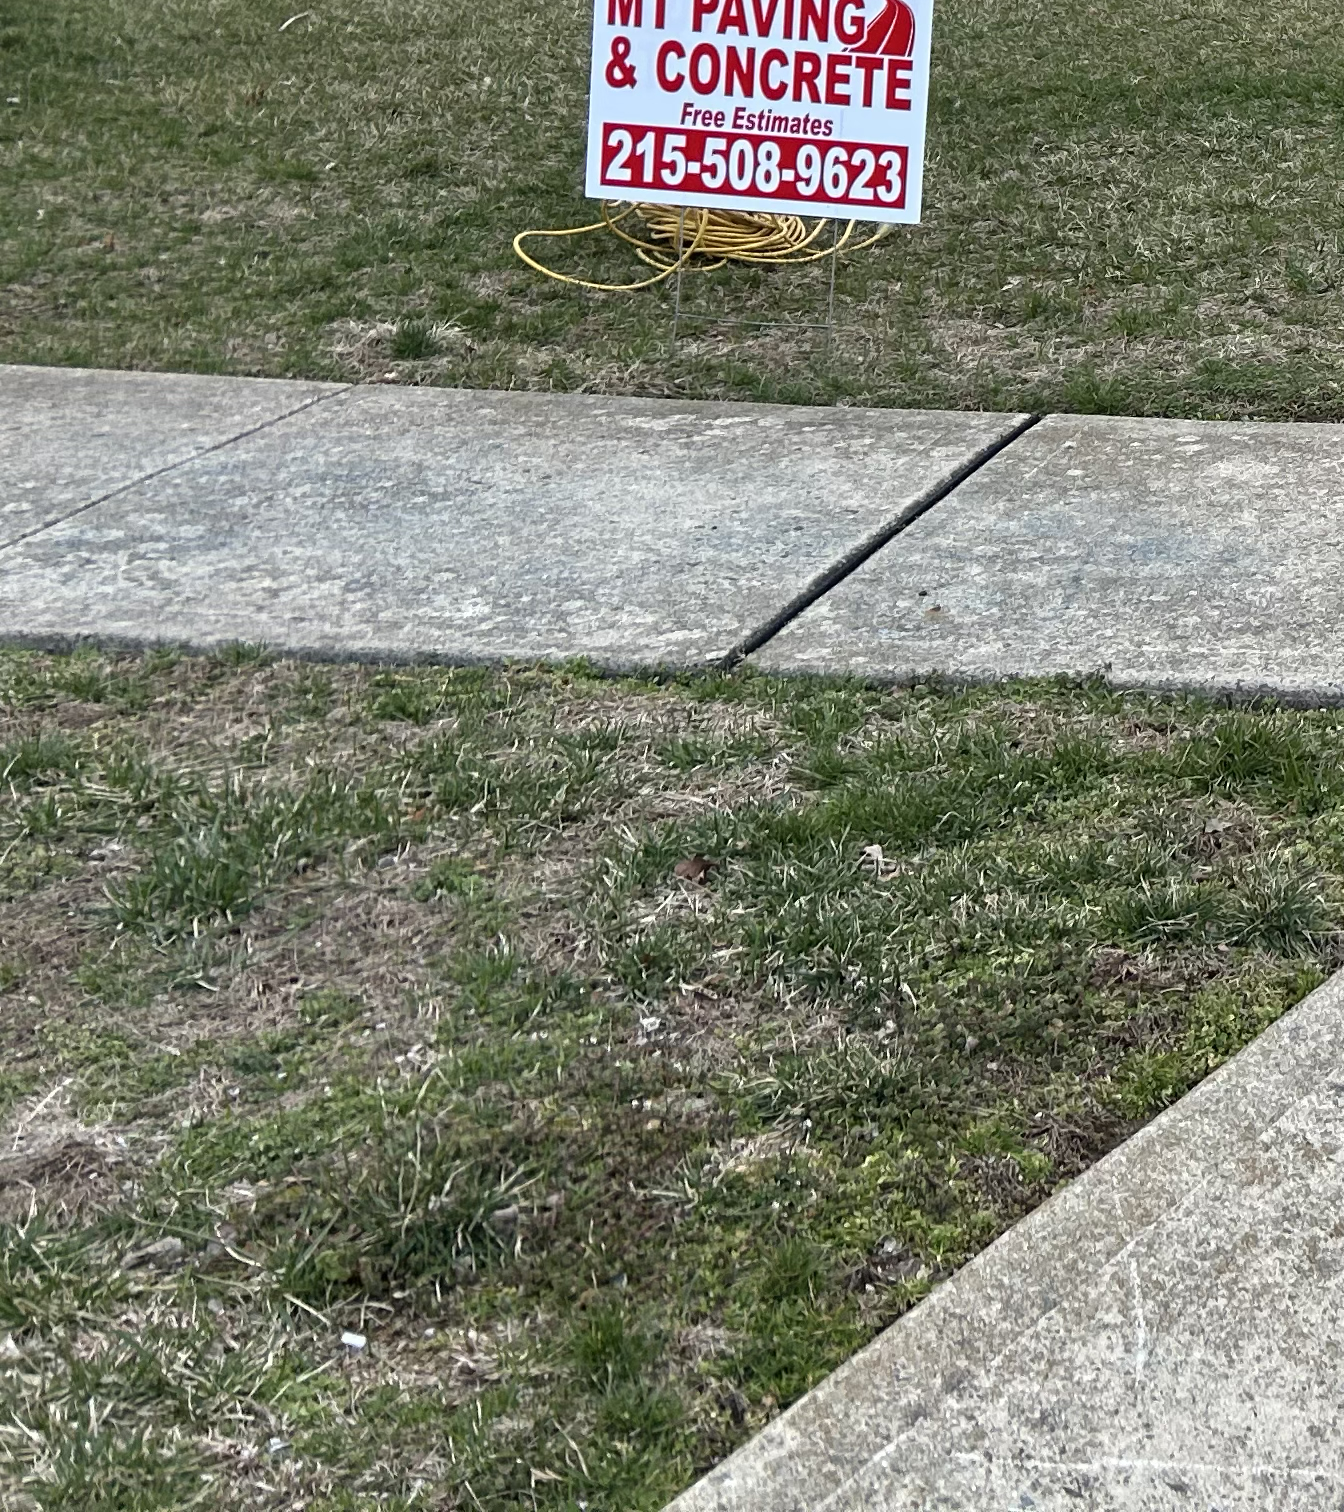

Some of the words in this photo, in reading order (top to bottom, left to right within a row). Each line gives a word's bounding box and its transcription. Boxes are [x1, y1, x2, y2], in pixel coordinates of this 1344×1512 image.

[605, 36, 637, 90] &
[656, 40, 913, 111] CONCRETE
[680, 102, 725, 129] Free
[731, 106, 834, 137] Estimates
[605, 129, 902, 203] 215-508-9623
